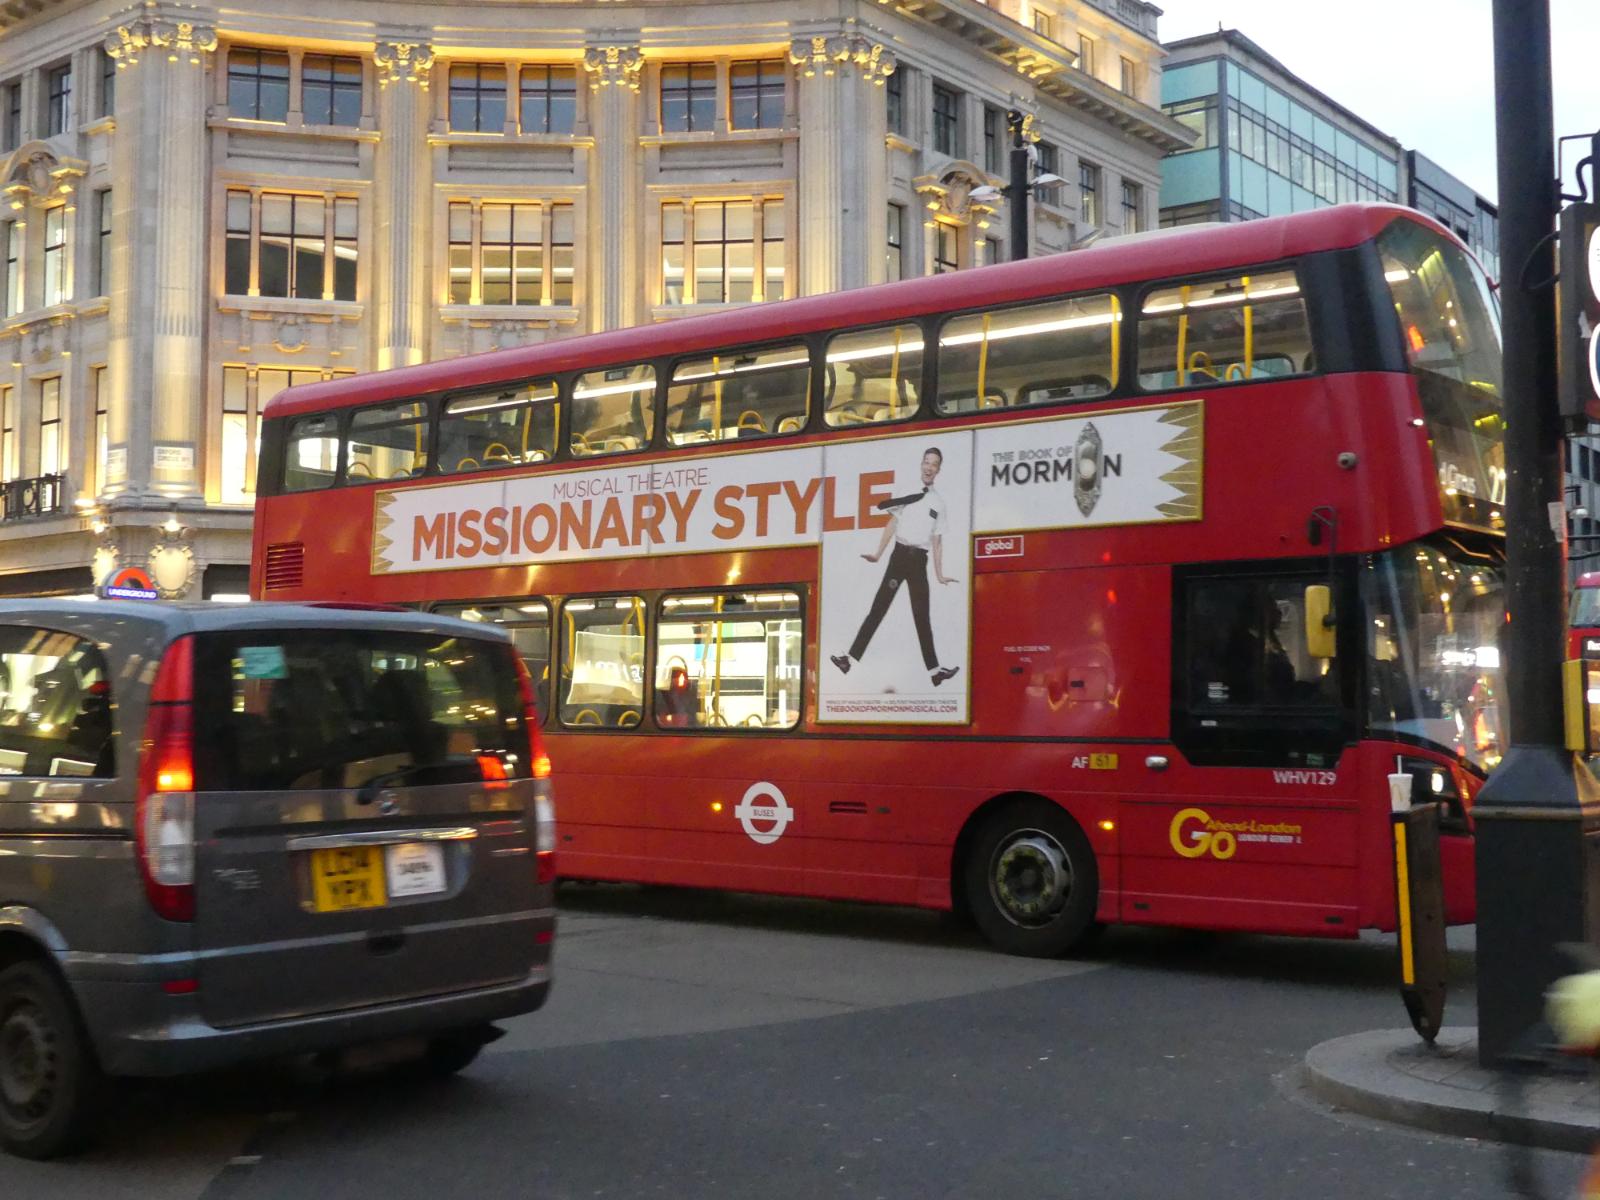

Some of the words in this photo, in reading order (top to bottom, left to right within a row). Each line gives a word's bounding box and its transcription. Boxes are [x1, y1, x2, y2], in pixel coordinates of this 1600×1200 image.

[992, 452, 1015, 463] THE
[1018, 448, 1053, 461] BOOK
[1056, 446, 1073, 458] OF
[552, 478, 623, 500] MUSICAL
[412, 489, 702, 562] MISSIONARY
[711, 470, 895, 540] STYLE
[985, 539, 1014, 554] global
[1072, 756, 1089, 769] AF
[1272, 770, 1337, 786] WHV129
[753, 809, 775, 817] BUSES
[1169, 807, 1236, 860] Go
